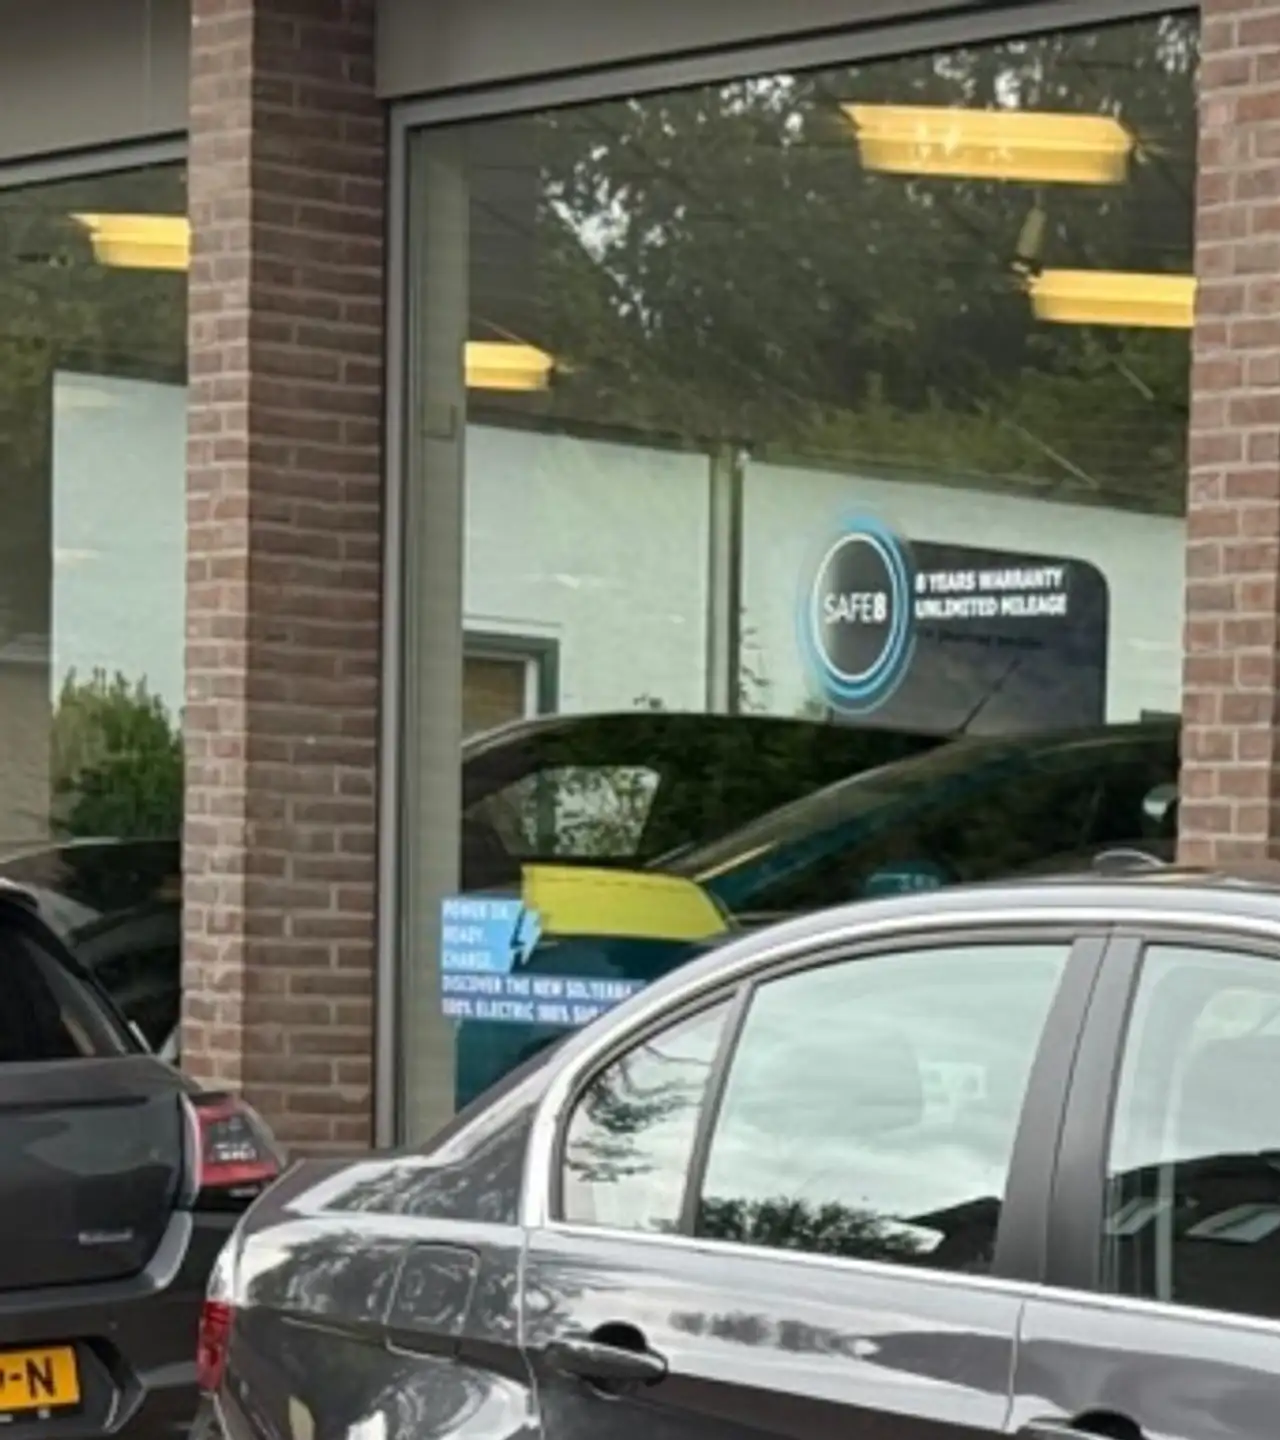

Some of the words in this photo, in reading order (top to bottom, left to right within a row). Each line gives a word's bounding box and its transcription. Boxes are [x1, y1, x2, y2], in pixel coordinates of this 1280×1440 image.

[929, 570, 976, 592] YEARS
[978, 567, 1064, 590] WARRANTY
[914, 596, 998, 619] UNLIMITED
[1000, 593, 1067, 617] MILEAGE
[442, 975, 501, 994] DISCOVER
[505, 978, 529, 996] THE
[532, 979, 562, 997] NEW
[476, 1000, 534, 1020] ELECTRIC
